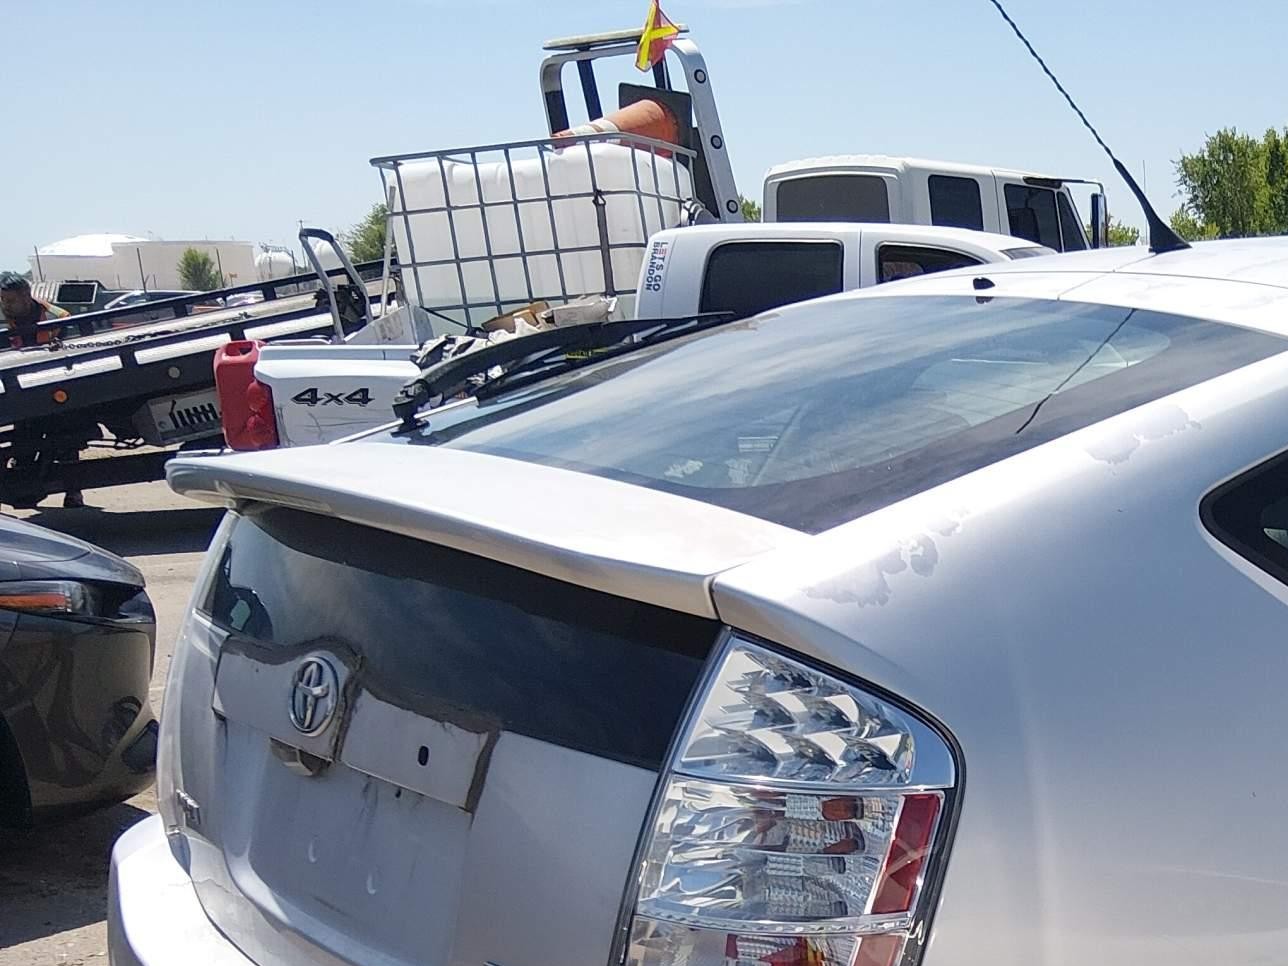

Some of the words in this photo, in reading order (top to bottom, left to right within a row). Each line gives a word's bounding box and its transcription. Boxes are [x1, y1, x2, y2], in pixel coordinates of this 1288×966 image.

[645, 242, 661, 290] BRANDON
[655, 242, 669, 271] LETS
[653, 275, 662, 291] GO
[292, 387, 376, 408] 4x4
